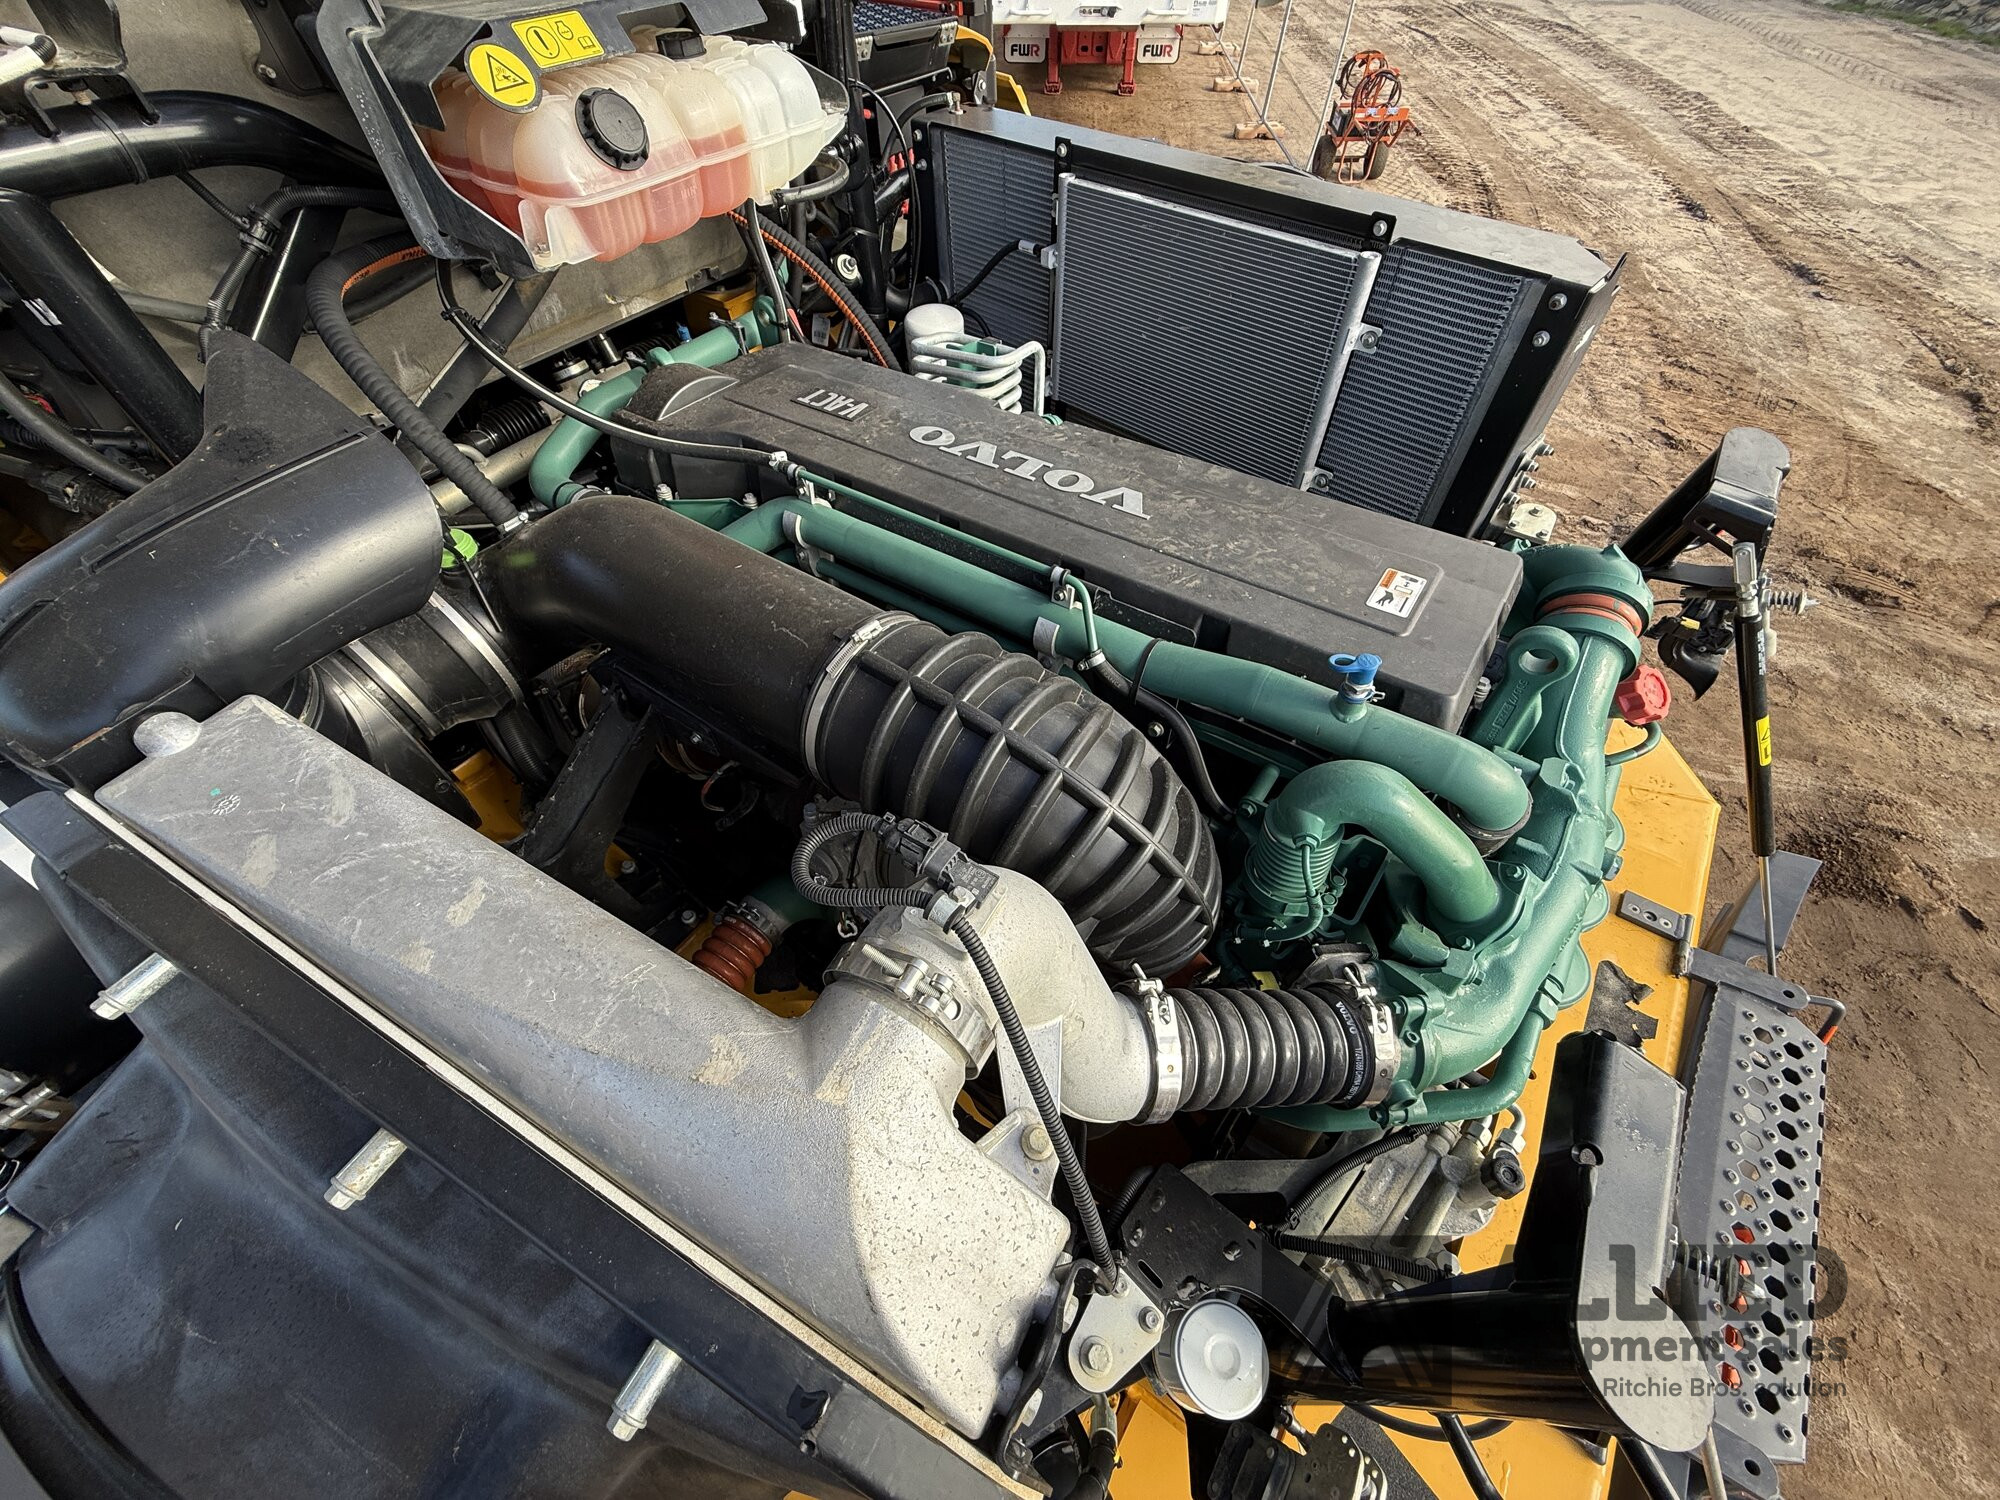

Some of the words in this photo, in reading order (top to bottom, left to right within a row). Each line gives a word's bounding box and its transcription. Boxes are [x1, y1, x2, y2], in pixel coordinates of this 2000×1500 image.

[1010, 44, 1040, 57] FWR
[1143, 44, 1173, 57] FWR
[797, 388, 869, 418] V-ACT
[909, 425, 1151, 520] VOLVO
[1335, 1001, 1358, 1035] VOLVO
